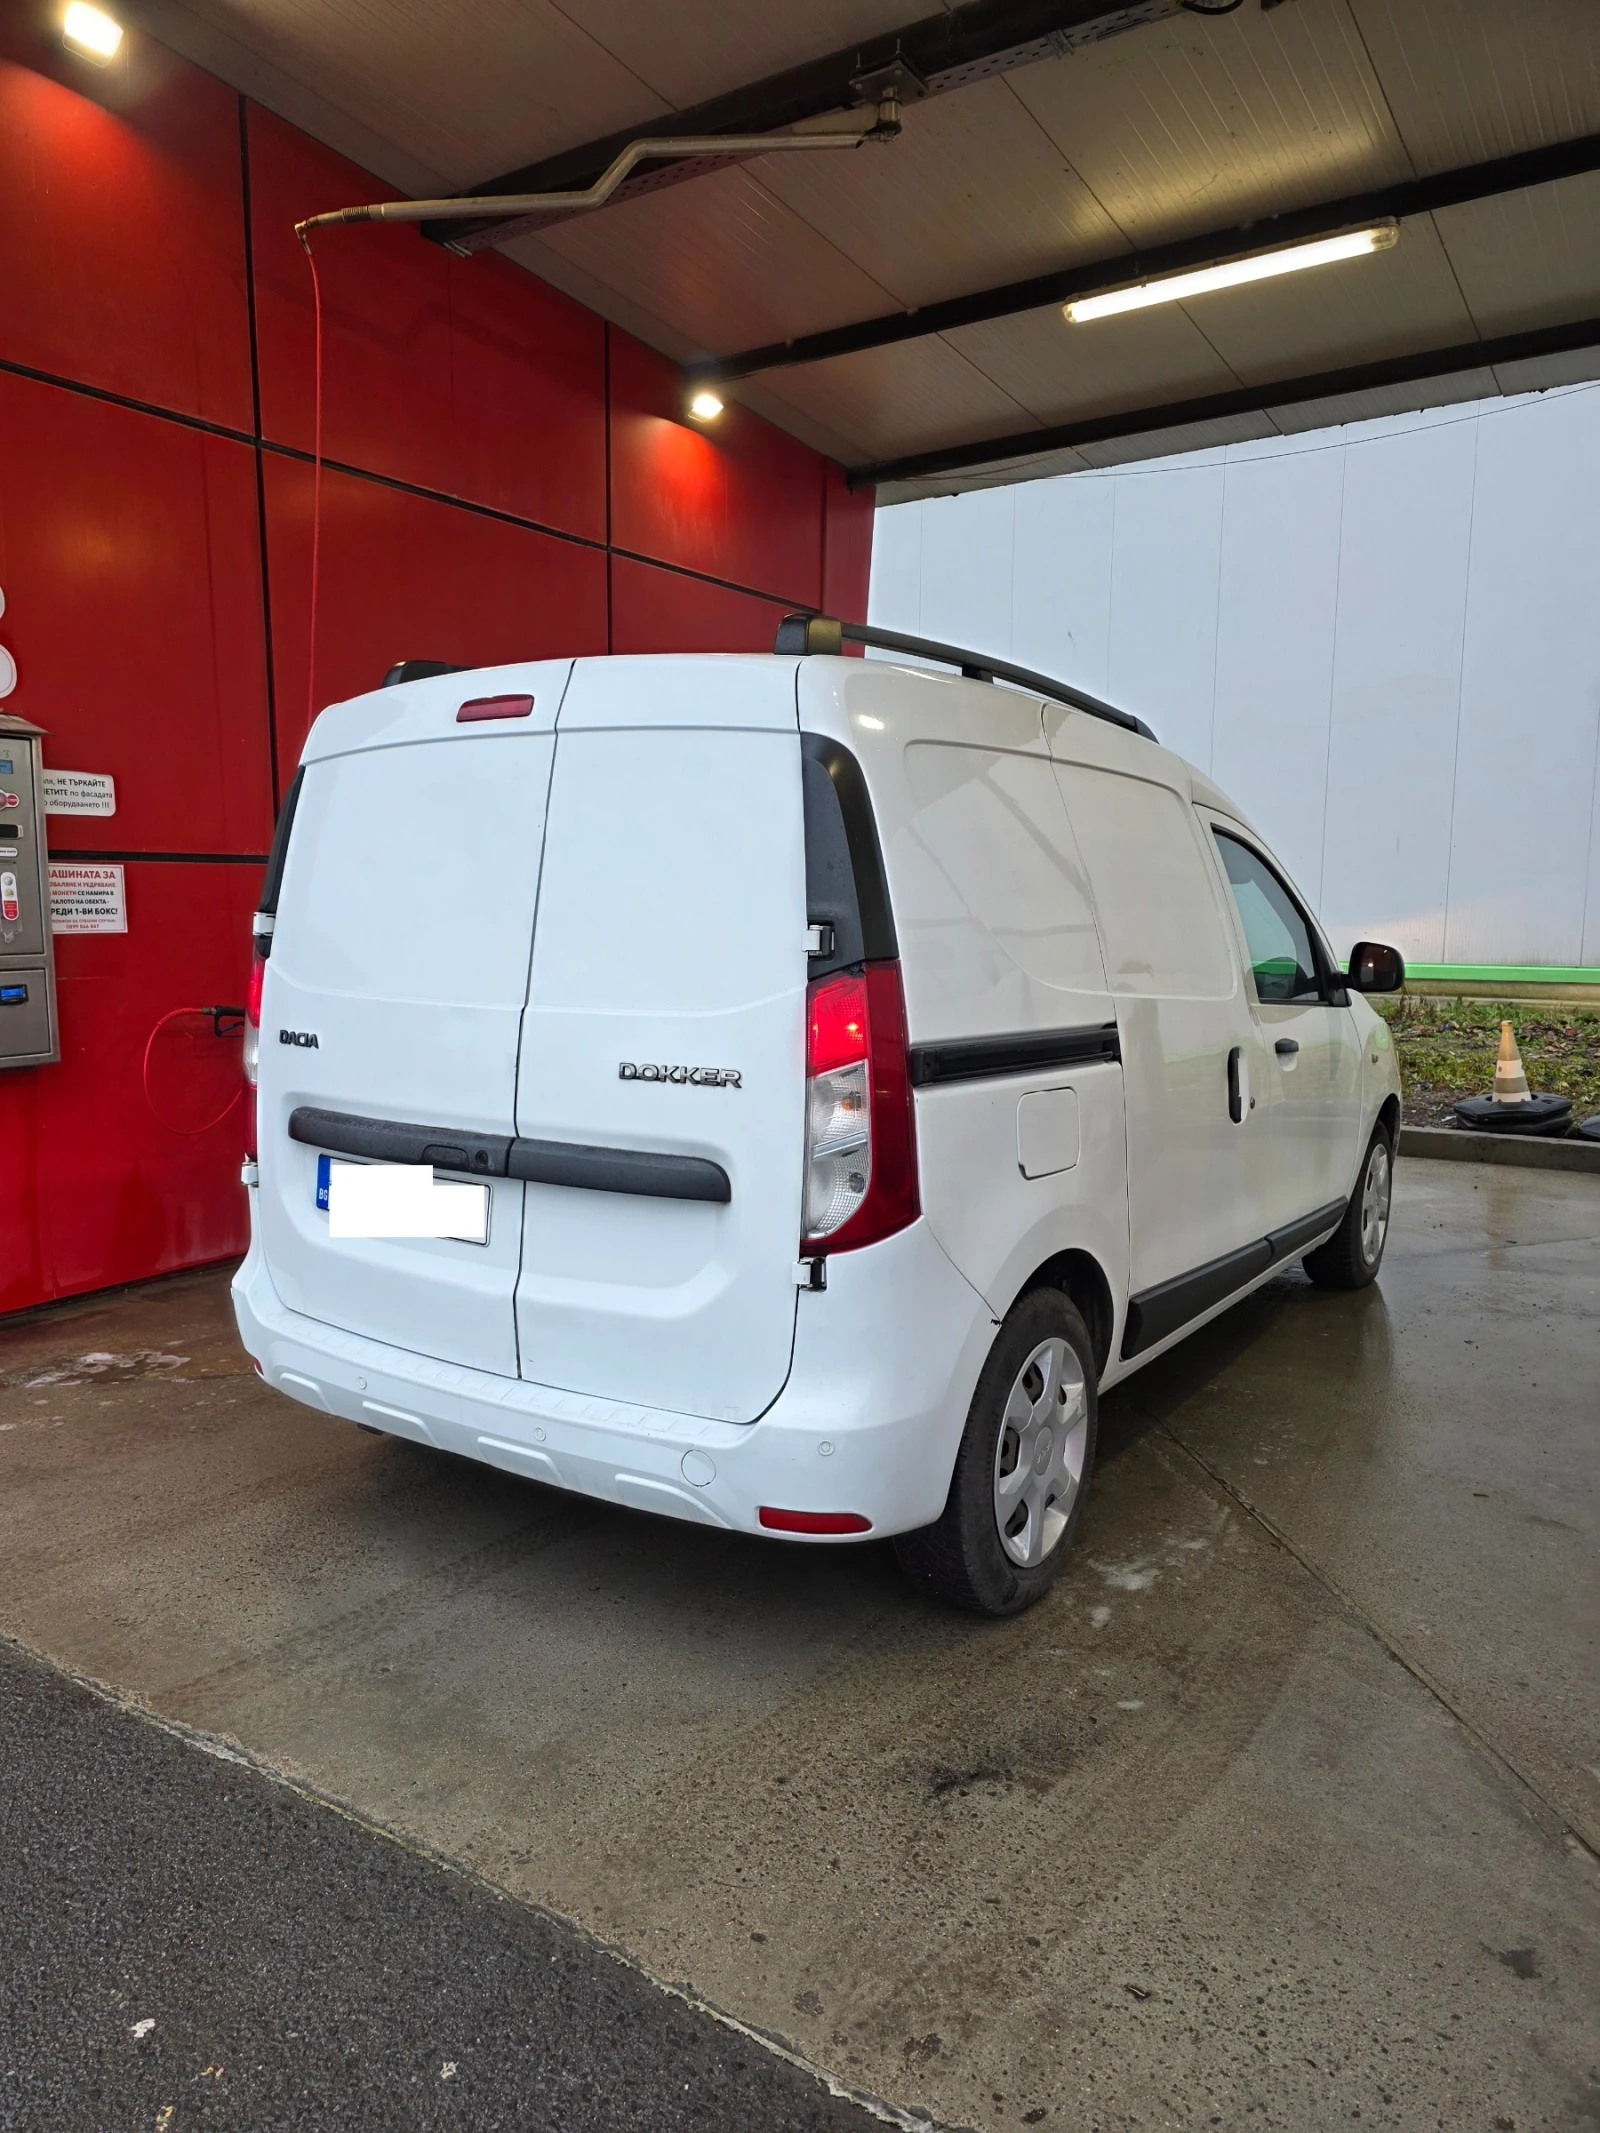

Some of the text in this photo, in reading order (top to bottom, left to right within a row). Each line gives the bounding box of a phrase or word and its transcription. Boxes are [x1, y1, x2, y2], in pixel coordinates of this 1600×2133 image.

[57, 778, 67, 786] НЕ
[68, 778, 106, 788] ТЪРКАЙТЕ
[43, 788, 69, 796] ЕТИТЕ
[81, 790, 113, 799] фасадата
[48, 869, 116, 879] АШИНАТА ЗА
[279, 1029, 319, 1050] DACIA
[618, 1062, 742, 1089] DOKKER
[318, 1187, 328, 1201] BG
